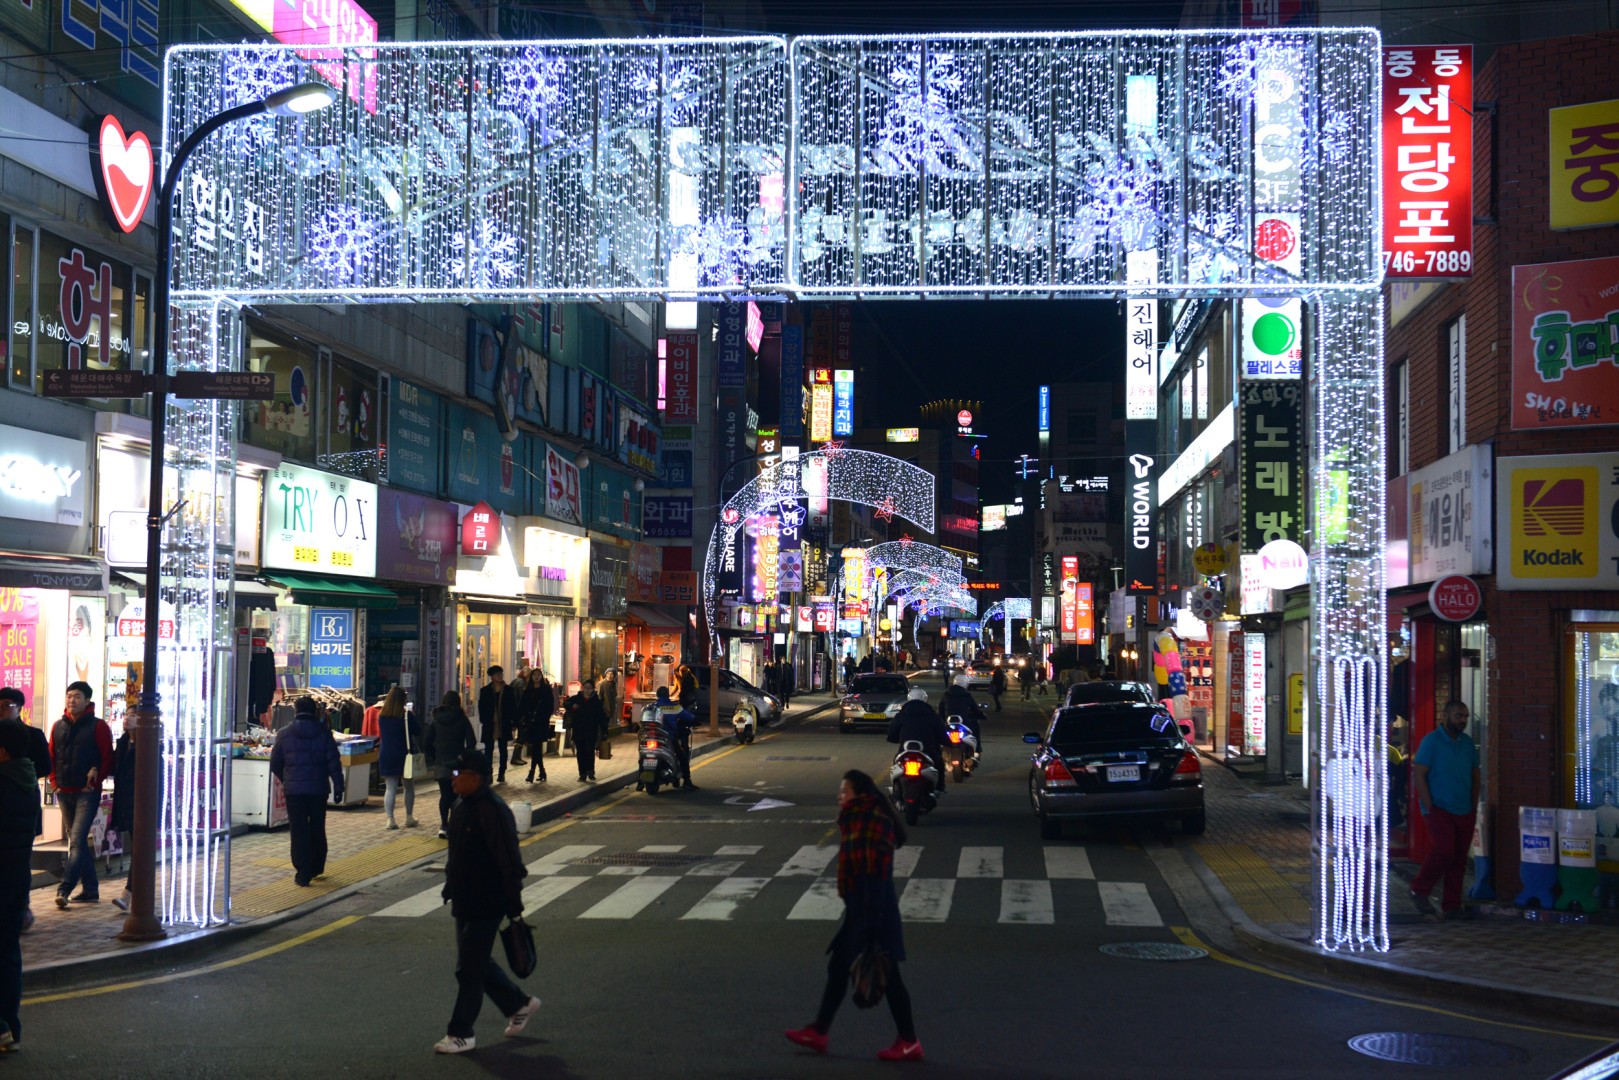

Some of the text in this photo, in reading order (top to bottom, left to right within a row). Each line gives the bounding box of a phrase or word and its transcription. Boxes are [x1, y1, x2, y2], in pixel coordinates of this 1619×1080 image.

[1386, 49, 1462, 77] 중동
[1395, 85, 1455, 243] 전당포
[1383, 250, 1471, 273] 746-7889
[673, 348, 692, 416] 이비인후과
[1254, 415, 1293, 546] 노래방
[279, 483, 318, 533] TRY
[1132, 482, 1150, 550] WORLD
[473, 513, 490, 551] 베르디
[1523, 549, 1585, 566] Kodak
[33, 574, 94, 587] TONYMOLY
[665, 586, 693, 600] 김밥
[1439, 593, 1475, 606] HALO
[7, 629, 28, 646] BIG
[3, 649, 33, 666] SALE
[311, 643, 352, 656] 보디가드
[310, 667, 352, 676] UNDERWEAR
